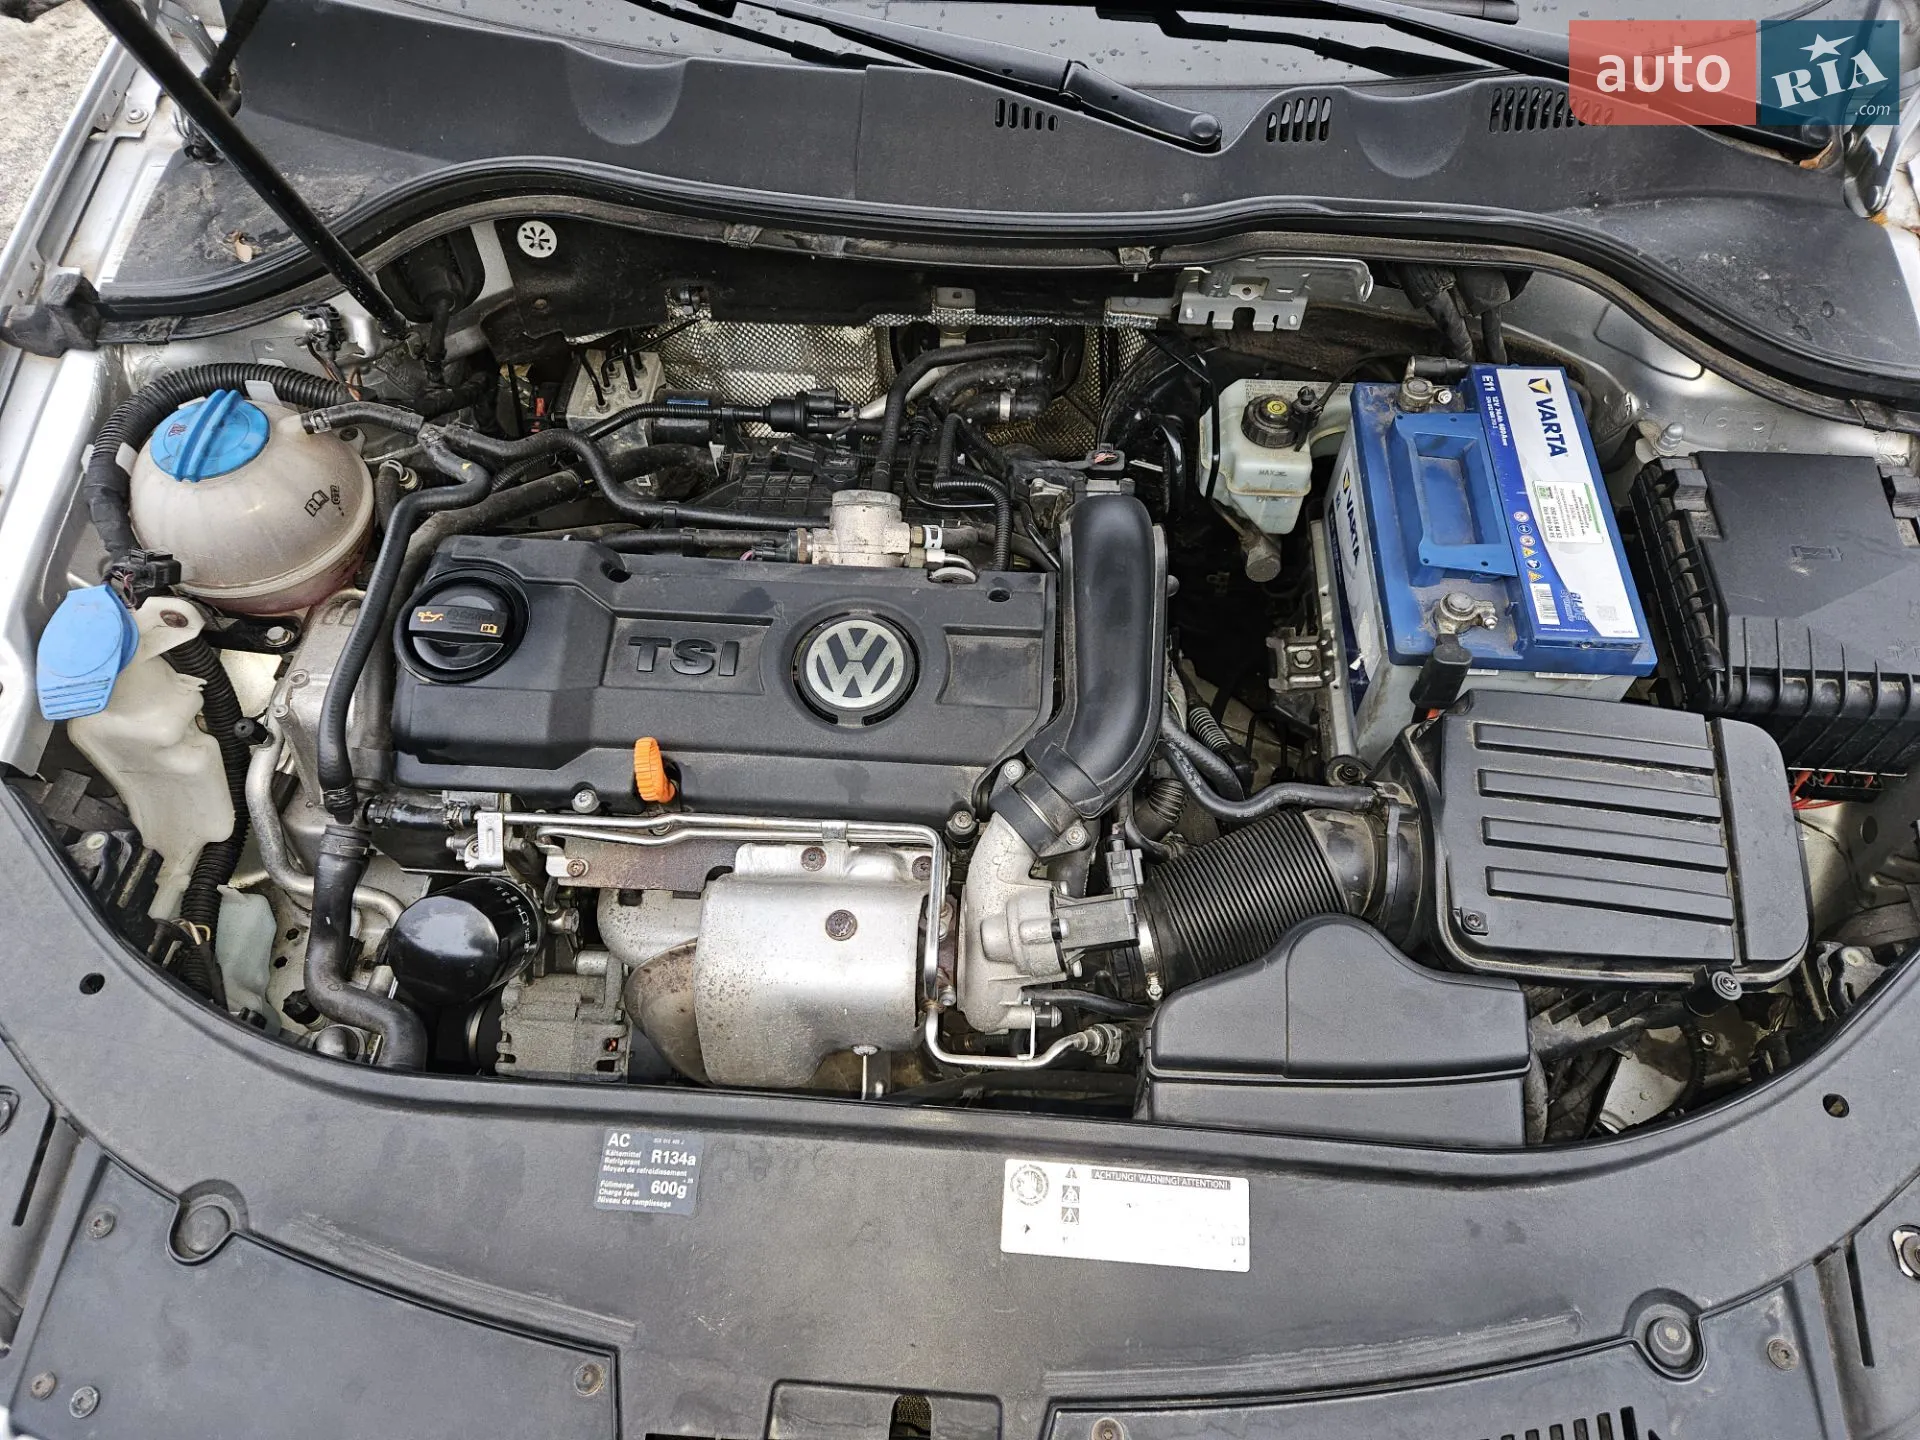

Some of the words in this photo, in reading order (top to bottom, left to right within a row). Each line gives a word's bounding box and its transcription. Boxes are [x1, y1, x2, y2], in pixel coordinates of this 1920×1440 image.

[1482, 375, 1496, 392] E11
[1536, 397, 1568, 457] VARTA
[1346, 489, 1360, 566] VARTA
[628, 636, 741, 677] TSI
[806, 620, 904, 708] VW
[607, 1133, 631, 1147] AC
[651, 1149, 697, 1166] R134a
[651, 1180, 687, 1199] 600g
[1094, 1170, 1137, 1182] ACHTUNG!
[1138, 1174, 1180, 1186] WARNING!
[1181, 1177, 1228, 1190] ATTENTION!
[597, 1196, 621, 1204] Niveau
[599, 1188, 623, 1197] Charge
